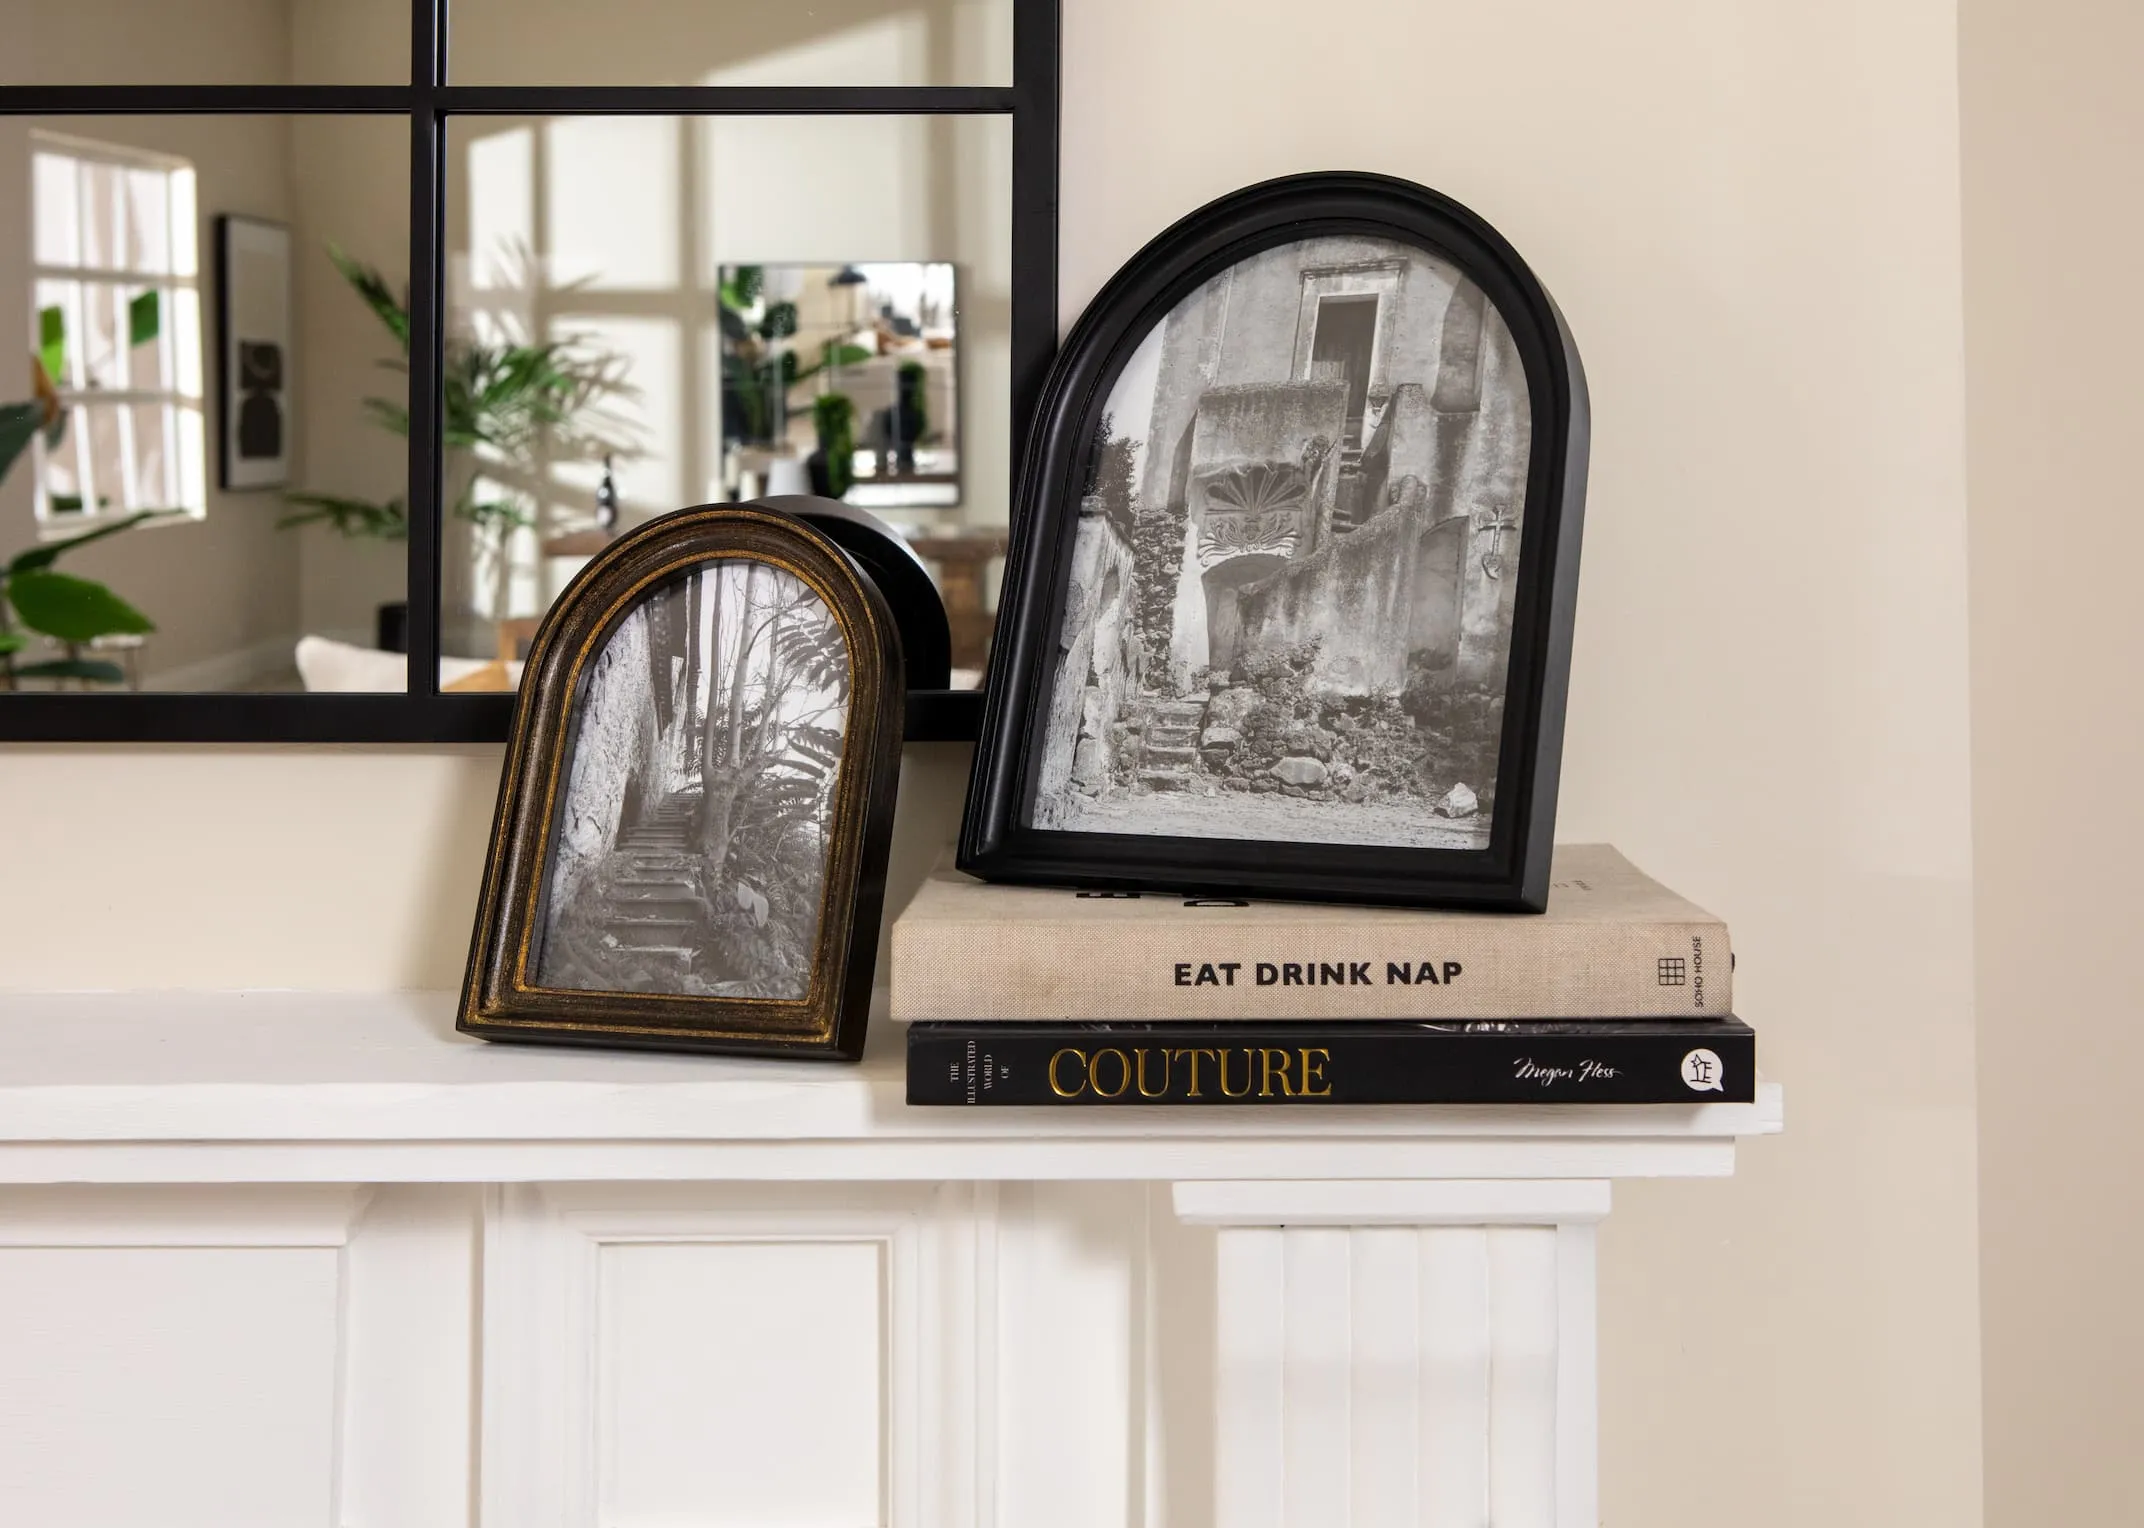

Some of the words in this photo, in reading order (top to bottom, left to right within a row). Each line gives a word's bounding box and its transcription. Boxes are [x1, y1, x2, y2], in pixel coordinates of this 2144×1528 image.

[1693, 936, 1702, 973] HOUSE
[1174, 963, 1241, 986] EAT
[1256, 962, 1373, 986] DRINK
[1386, 962, 1463, 985] NAP
[1694, 976, 1704, 1008] SOHO
[950, 1062, 960, 1082] THE
[967, 1040, 976, 1104] ILLUSTRATED
[983, 1054, 993, 1090] WORLD
[1000, 1065, 1009, 1079] OF
[1049, 1048, 1332, 1097] COUTURE
[1513, 1058, 1573, 1087] Megan
